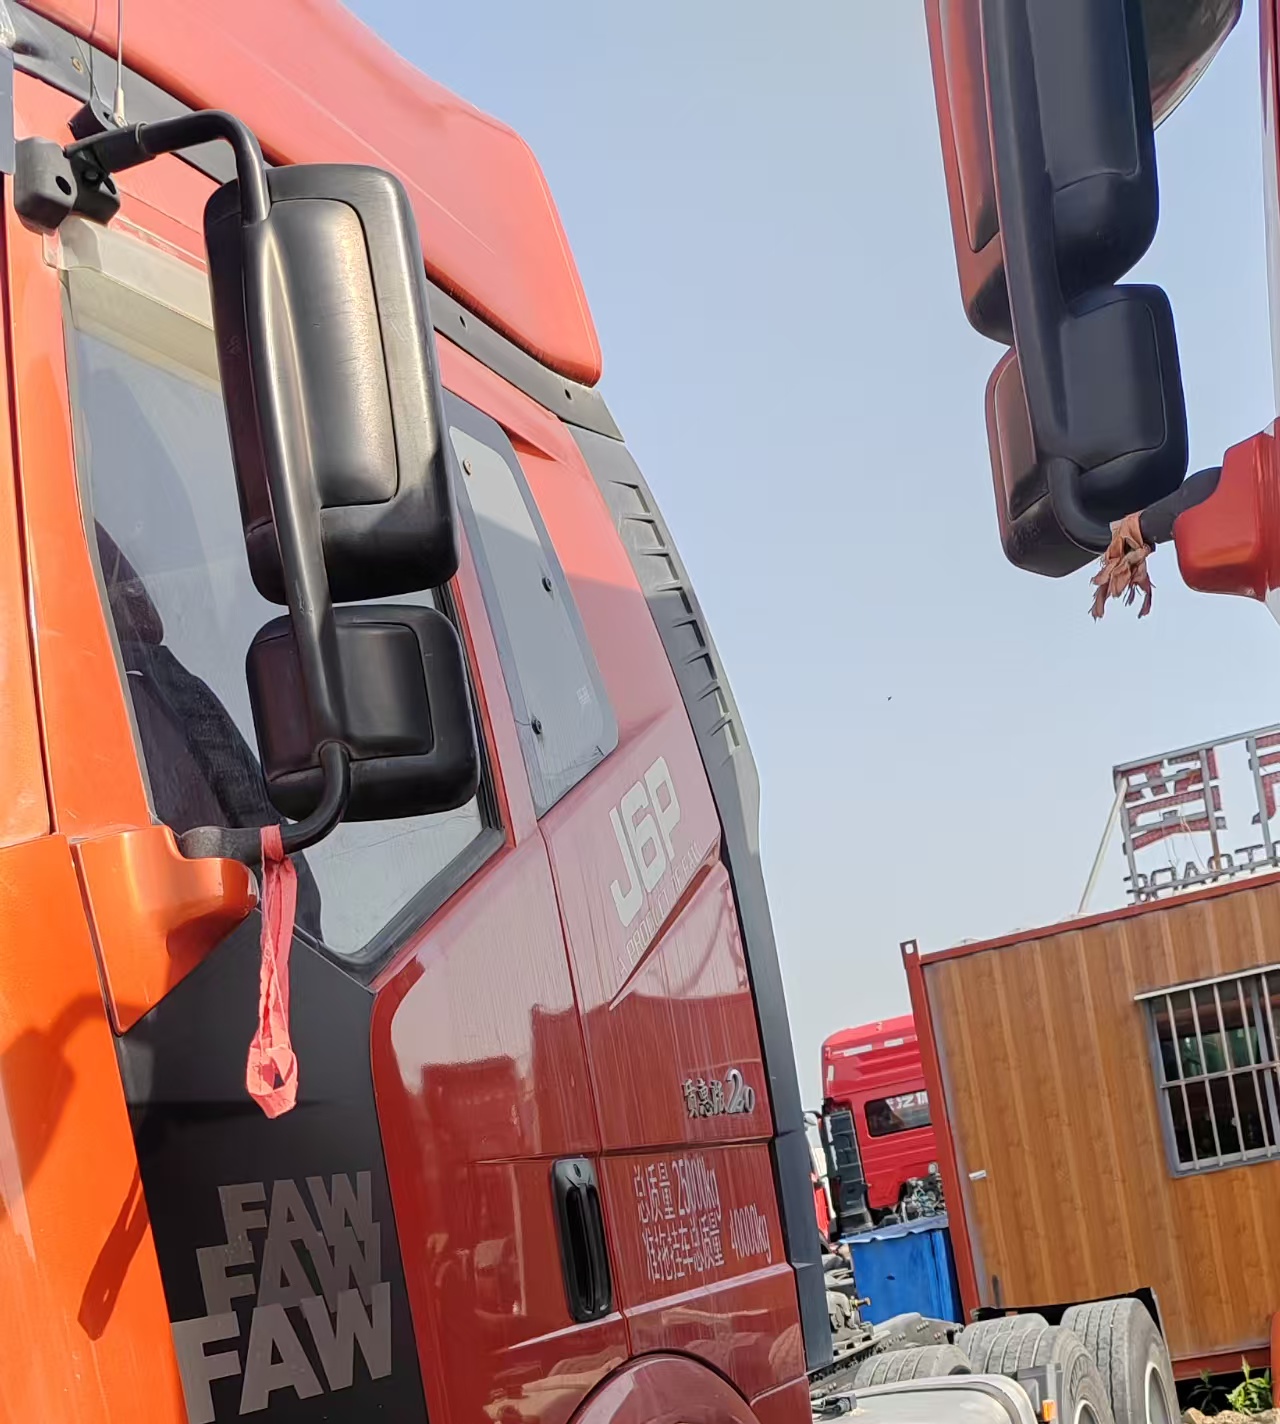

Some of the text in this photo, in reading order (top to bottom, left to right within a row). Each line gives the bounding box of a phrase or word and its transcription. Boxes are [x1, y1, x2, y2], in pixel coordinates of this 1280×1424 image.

[609, 756, 681, 928] J6P
[218, 1171, 373, 1253] FAW
[633, 1156, 722, 1224] 总质量 25000kg
[196, 1221, 381, 1316] FAW
[729, 1202, 772, 1265] 40000kg
